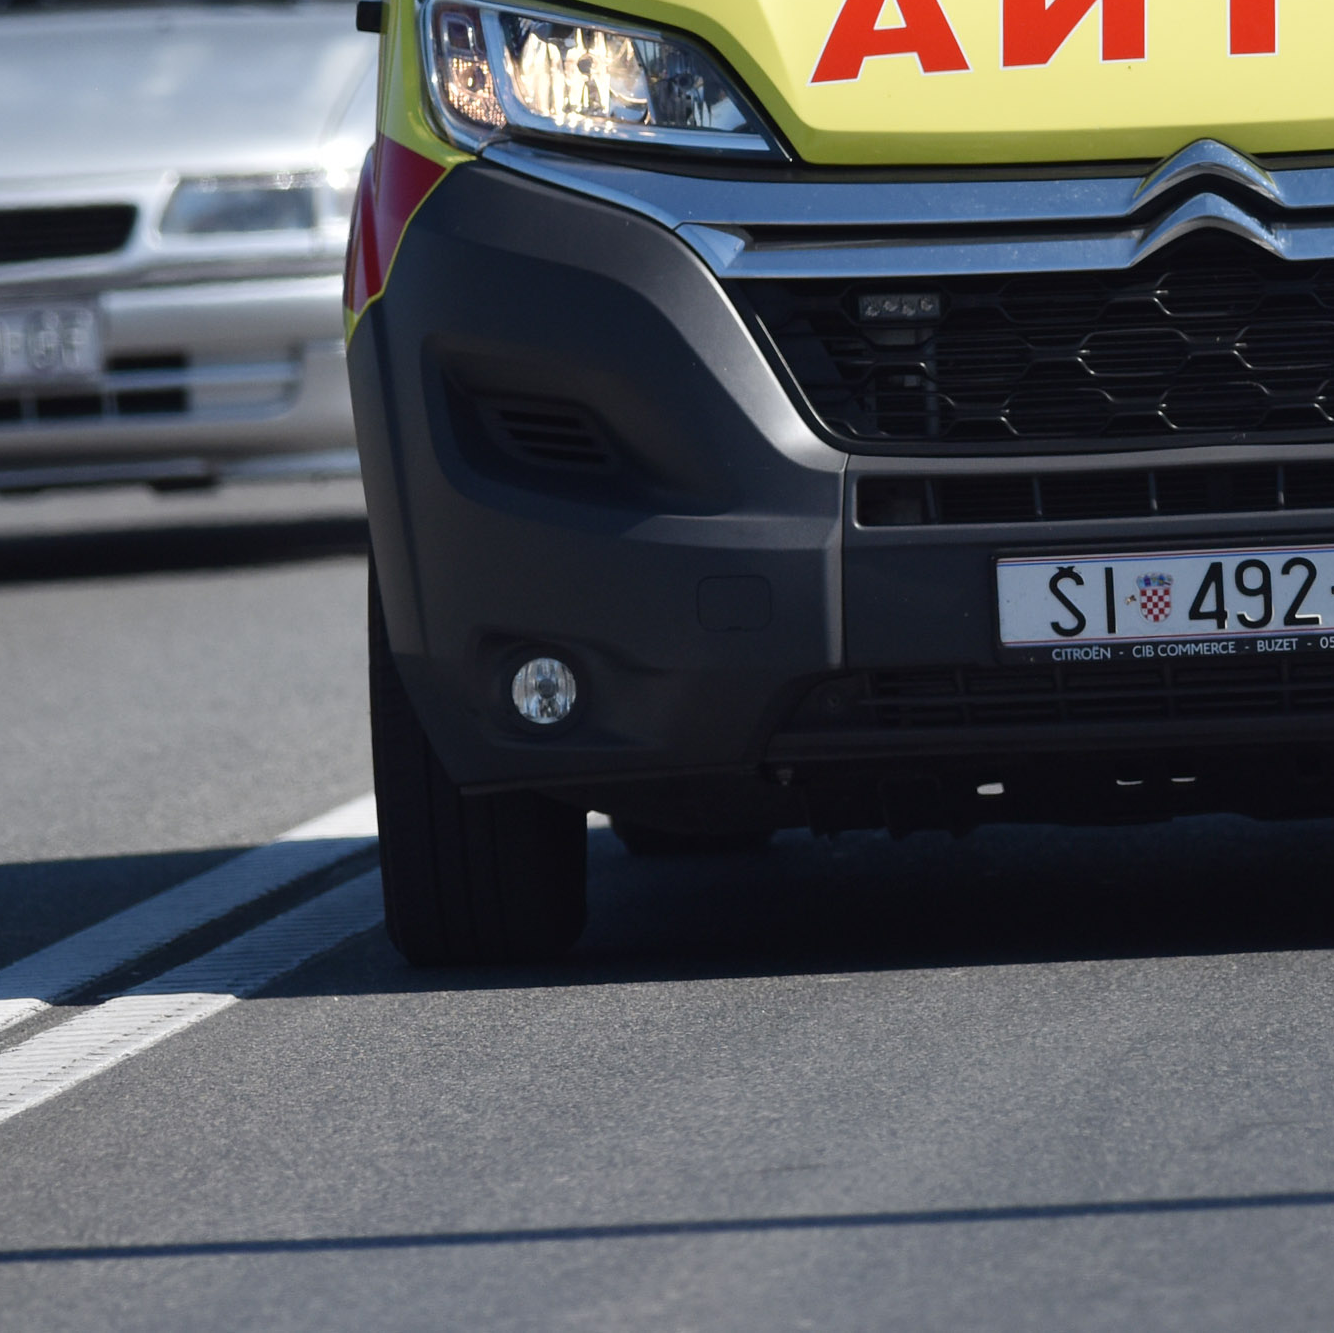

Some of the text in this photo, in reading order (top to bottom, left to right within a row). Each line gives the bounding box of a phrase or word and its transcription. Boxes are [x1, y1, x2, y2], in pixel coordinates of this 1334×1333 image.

[1049, 566, 1117, 637] ŠI
[1051, 645, 1111, 662] CITROËN
[1132, 645, 1155, 658] CIB
[1157, 641, 1236, 657] COMMERCE
[1256, 638, 1298, 652] BUZET
